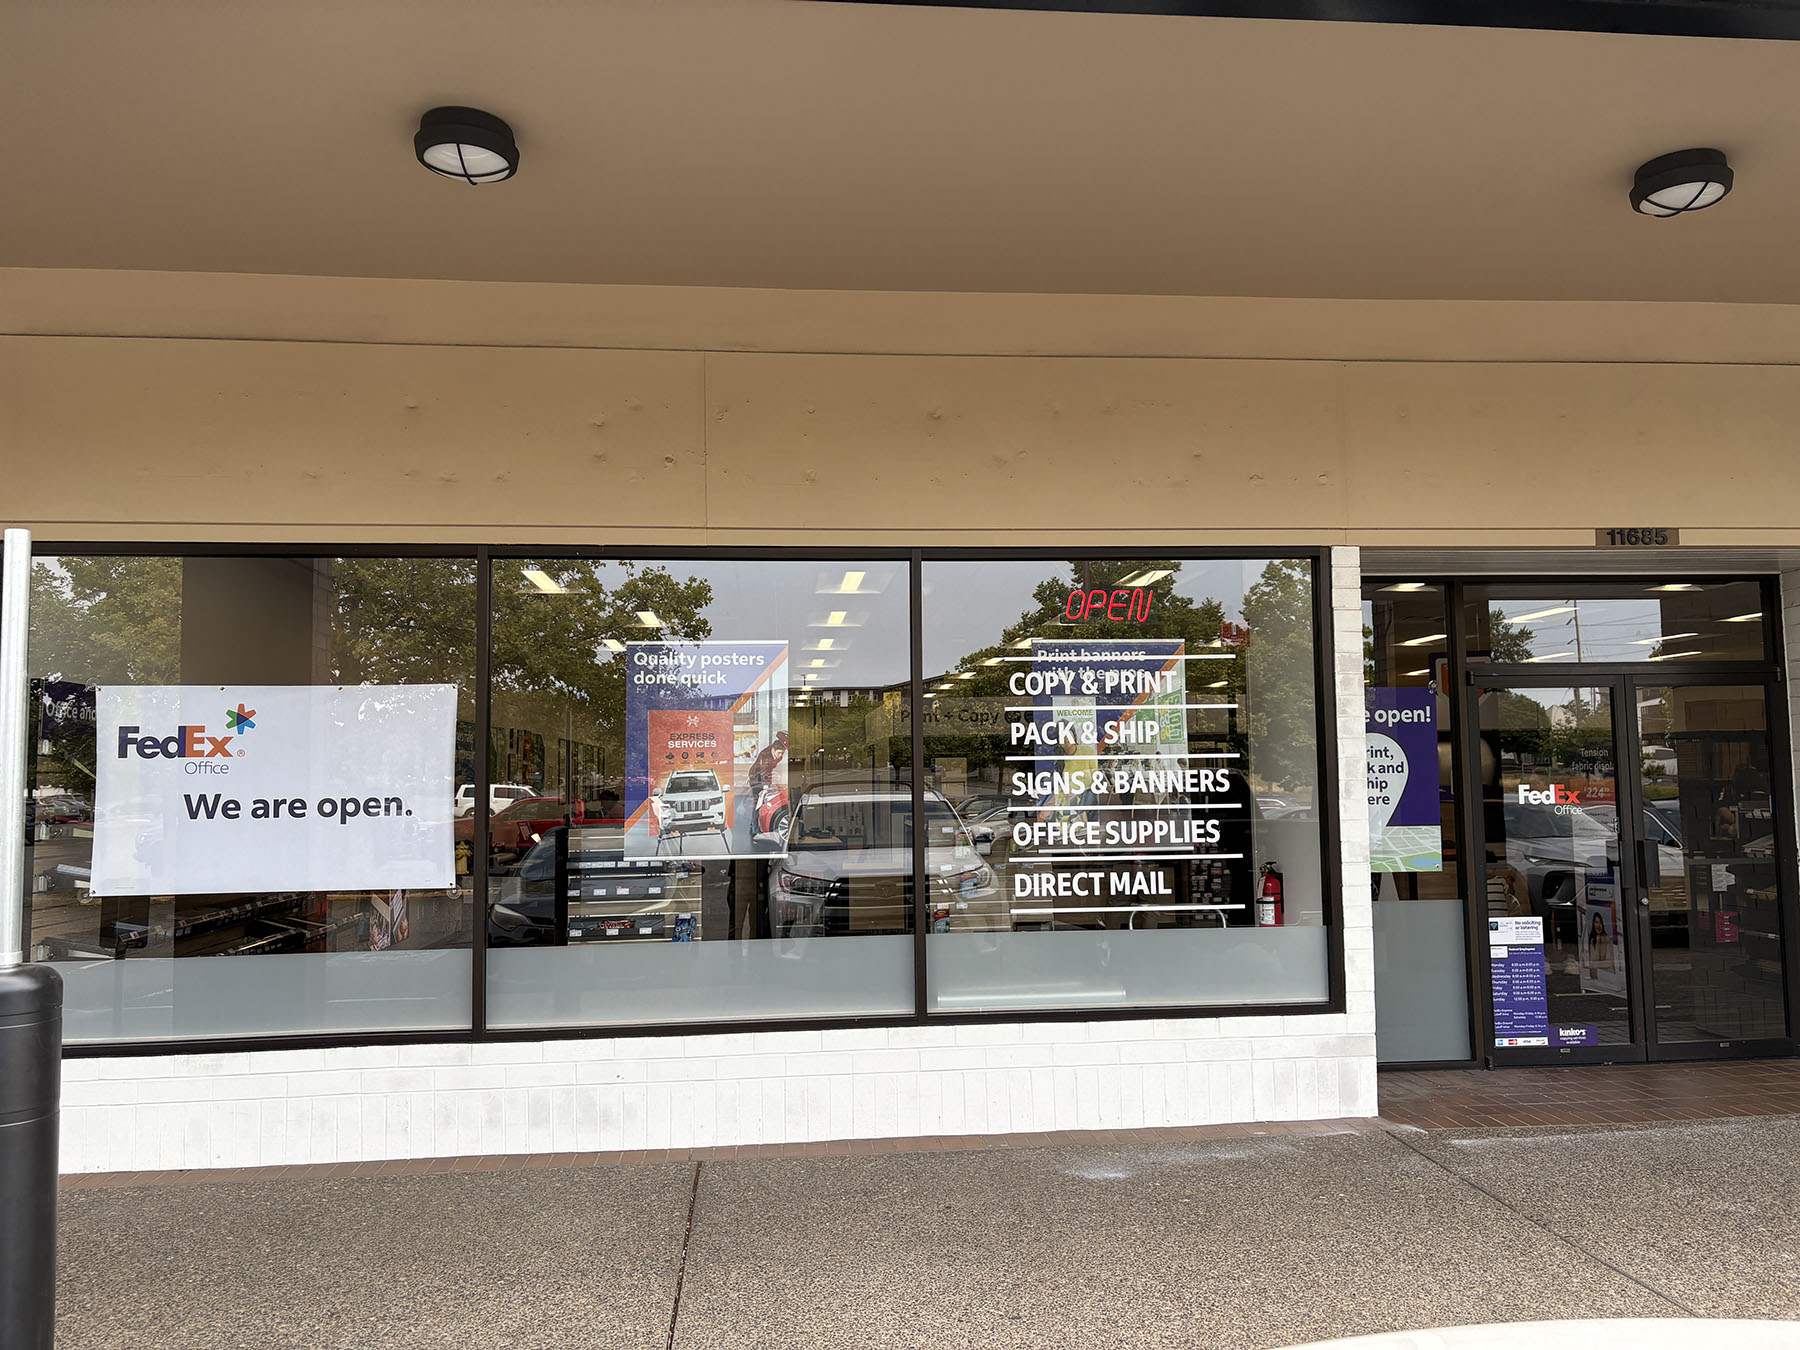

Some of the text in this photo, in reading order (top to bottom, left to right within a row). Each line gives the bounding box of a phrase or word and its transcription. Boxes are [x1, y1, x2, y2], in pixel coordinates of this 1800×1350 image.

[1606, 528, 1668, 545] 11685
[1065, 588, 1154, 623] OPEN
[633, 652, 765, 669] Quality posters
[1037, 648, 1146, 662] Print banners
[633, 671, 727, 687] done quick
[1009, 671, 1177, 695] COPY & PRINT
[1056, 708, 1093, 717] WELCOME
[1374, 706, 1432, 727] open!
[1010, 720, 1160, 746] PACK & SHIP
[117, 725, 234, 759] FedEx
[1366, 746, 1394, 760] int,
[1580, 748, 1609, 758] Tension
[184, 761, 229, 775] Office
[1378, 762, 1405, 774] and
[1571, 761, 1593, 771] fabric
[1011, 769, 1230, 796] SIGNS & BANNERS
[1367, 777, 1389, 792] hip
[1367, 796, 1390, 805] ere
[1518, 784, 1581, 805] FedEx
[183, 793, 413, 825] We are open.
[1554, 805, 1583, 815] Office
[1012, 819, 1221, 846] OFFICE SUPPLIES
[1014, 871, 1173, 898] DIRECT MAIL
